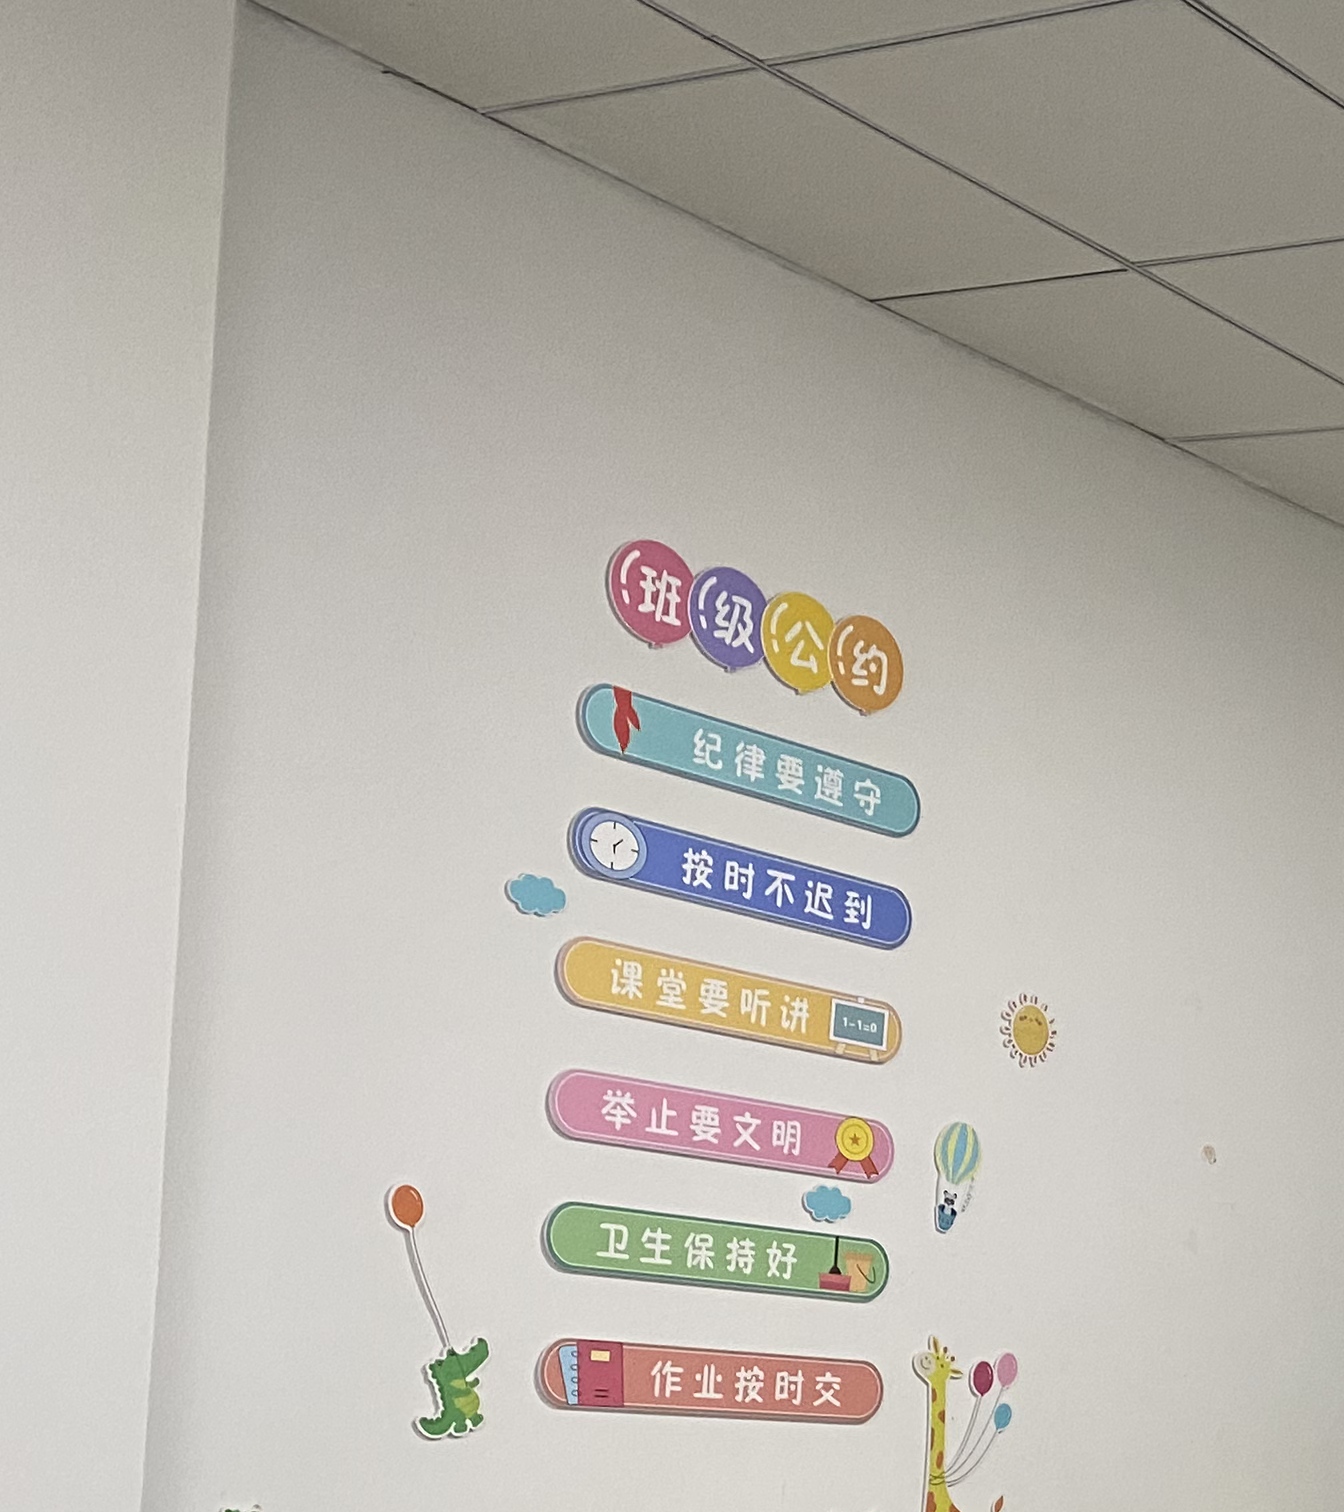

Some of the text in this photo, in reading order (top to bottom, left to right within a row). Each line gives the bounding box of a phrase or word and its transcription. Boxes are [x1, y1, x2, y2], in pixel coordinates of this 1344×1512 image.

[637, 565, 889, 696] 班级公约
[692, 728, 882, 816] 纪律要遵守
[681, 847, 874, 930] 按时不迟到
[610, 958, 810, 1034] 课堂要听讲
[841, 1015, 878, 1034] 1-1=0
[600, 1088, 802, 1156] 举止要文明
[596, 1221, 798, 1281] 卫生保持好
[649, 1360, 843, 1408] 作业按时交
